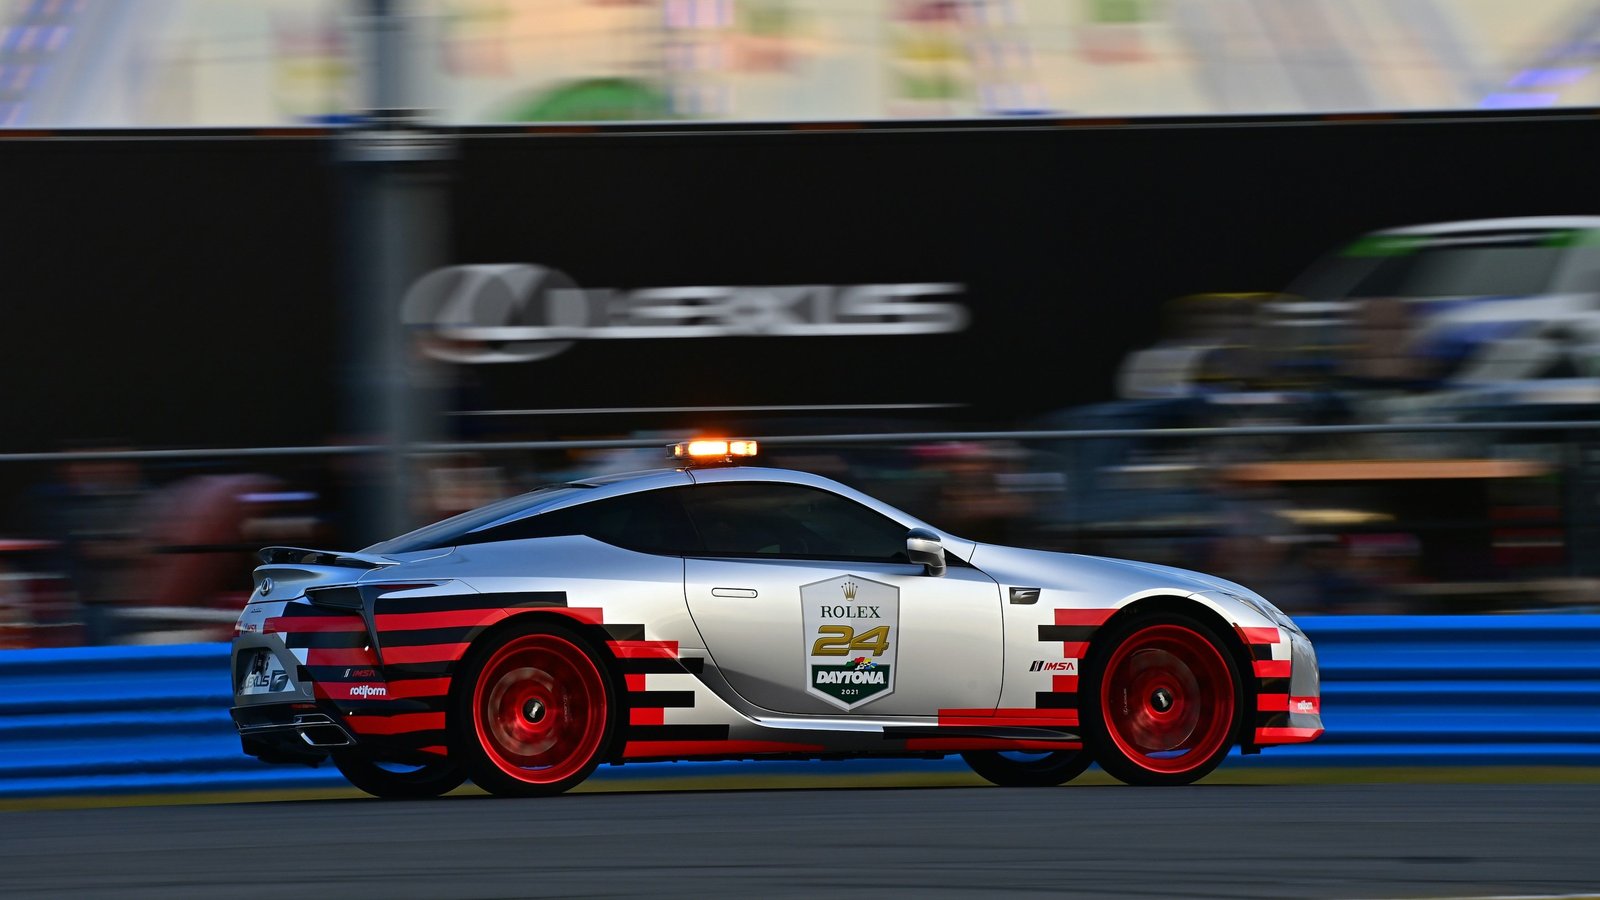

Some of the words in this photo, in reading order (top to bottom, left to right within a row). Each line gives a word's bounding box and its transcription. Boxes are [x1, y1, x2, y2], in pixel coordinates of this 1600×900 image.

[820, 605, 881, 619] ROLEX
[811, 625, 890, 656] 24
[1043, 662, 1075, 671] IMSA
[816, 670, 885, 685] DAYTONA
[350, 685, 386, 698] rotiform
